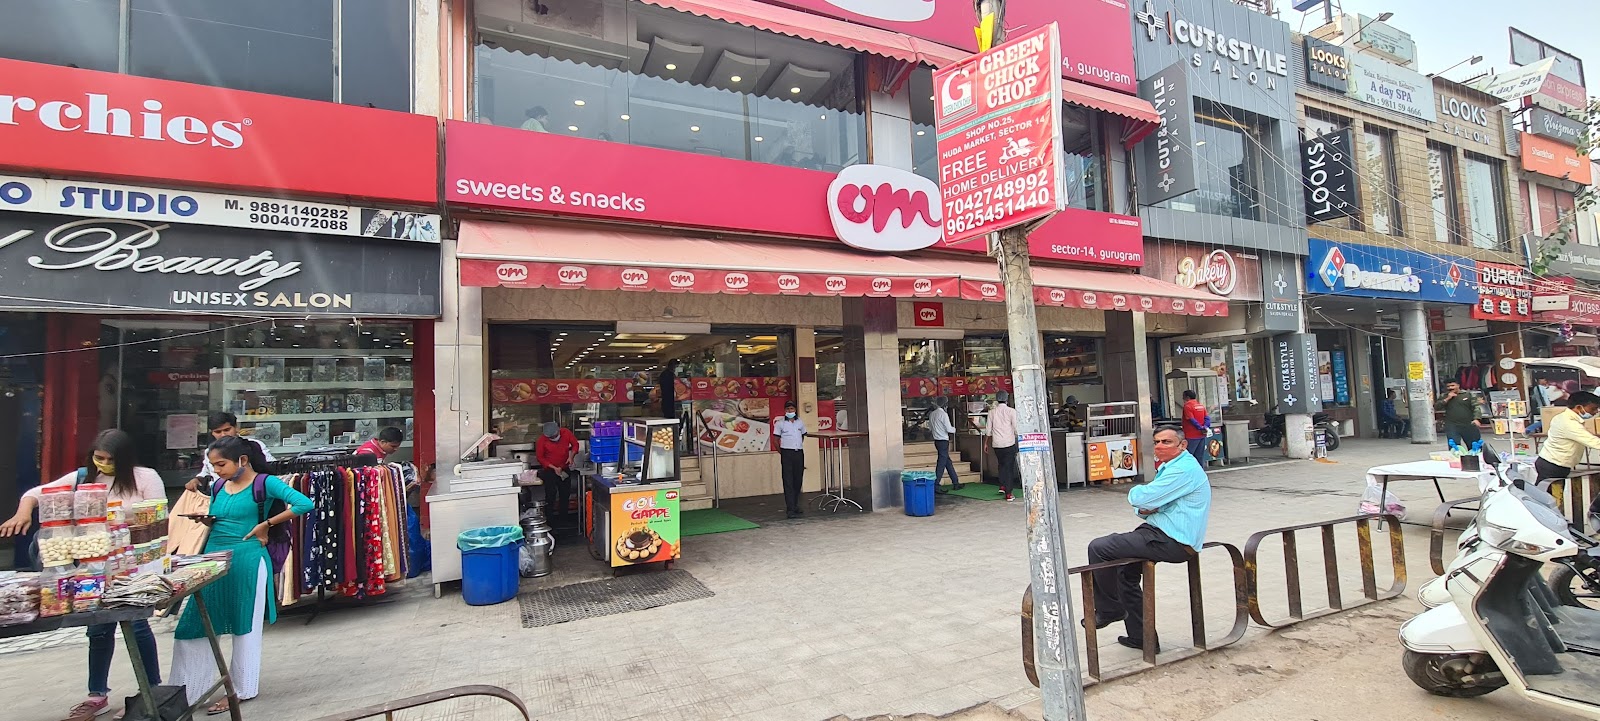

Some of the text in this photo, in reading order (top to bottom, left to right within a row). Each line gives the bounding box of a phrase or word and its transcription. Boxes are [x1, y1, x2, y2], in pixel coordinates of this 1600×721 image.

[979, 33, 1045, 75] GREEN
[1175, 19, 1287, 76] CUT&STYLE
[1311, 47, 1345, 68] LOOKS
[984, 55, 1040, 91] CHICK
[1077, 62, 1131, 85] gurugram
[1193, 53, 1276, 90] SALON
[1313, 63, 1346, 80] SALON
[1496, 84, 1516, 95] day
[1519, 75, 1542, 88] SPA
[942, 69, 972, 116] G
[987, 76, 1037, 108] CHOP
[1366, 93, 1375, 103] Ph
[1381, 98, 1396, 110] 9811
[1398, 103, 1406, 111] 59
[1407, 106, 1422, 117] 4666
[1370, 81, 1413, 103] A day SPA
[1168, 83, 1180, 152] SALON
[1441, 94, 1487, 127] LOOKS
[942, 146, 962, 159] HUDA
[963, 132, 997, 151] MARKET,
[998, 120, 1032, 137] SECTOR
[1035, 115, 1045, 124] 14
[965, 125, 986, 139] SHOP
[987, 116, 1014, 130] NO.25,
[1443, 122, 1490, 145] SALON
[942, 150, 988, 182] FREE
[943, 152, 1046, 199] HOME DELIVERY
[1307, 142, 1331, 215] LOOKS
[1331, 135, 1348, 209] SALON
[59, 185, 199, 217] STUDIO
[456, 179, 646, 212] sweets & snacks
[838, 183, 941, 233] om
[945, 168, 1048, 218] 7042748992
[224, 198, 349, 221] M. 9891140282
[249, 213, 349, 231] 9004072088
[946, 187, 1050, 236] 9625451440
[28, 218, 301, 291] Beauty
[1051, 244, 1141, 262] sector-14, gurugram
[1177, 254, 1227, 289] Bakery
[1482, 267, 1523, 286] DURGA
[173, 290, 353, 309] UNISEX SALON
[1266, 302, 1298, 312] CUT&STYLE
[1280, 341, 1291, 391] CUT&STYLE
[623, 496, 658, 511] GOL
[630, 508, 670, 520] GAPPE
